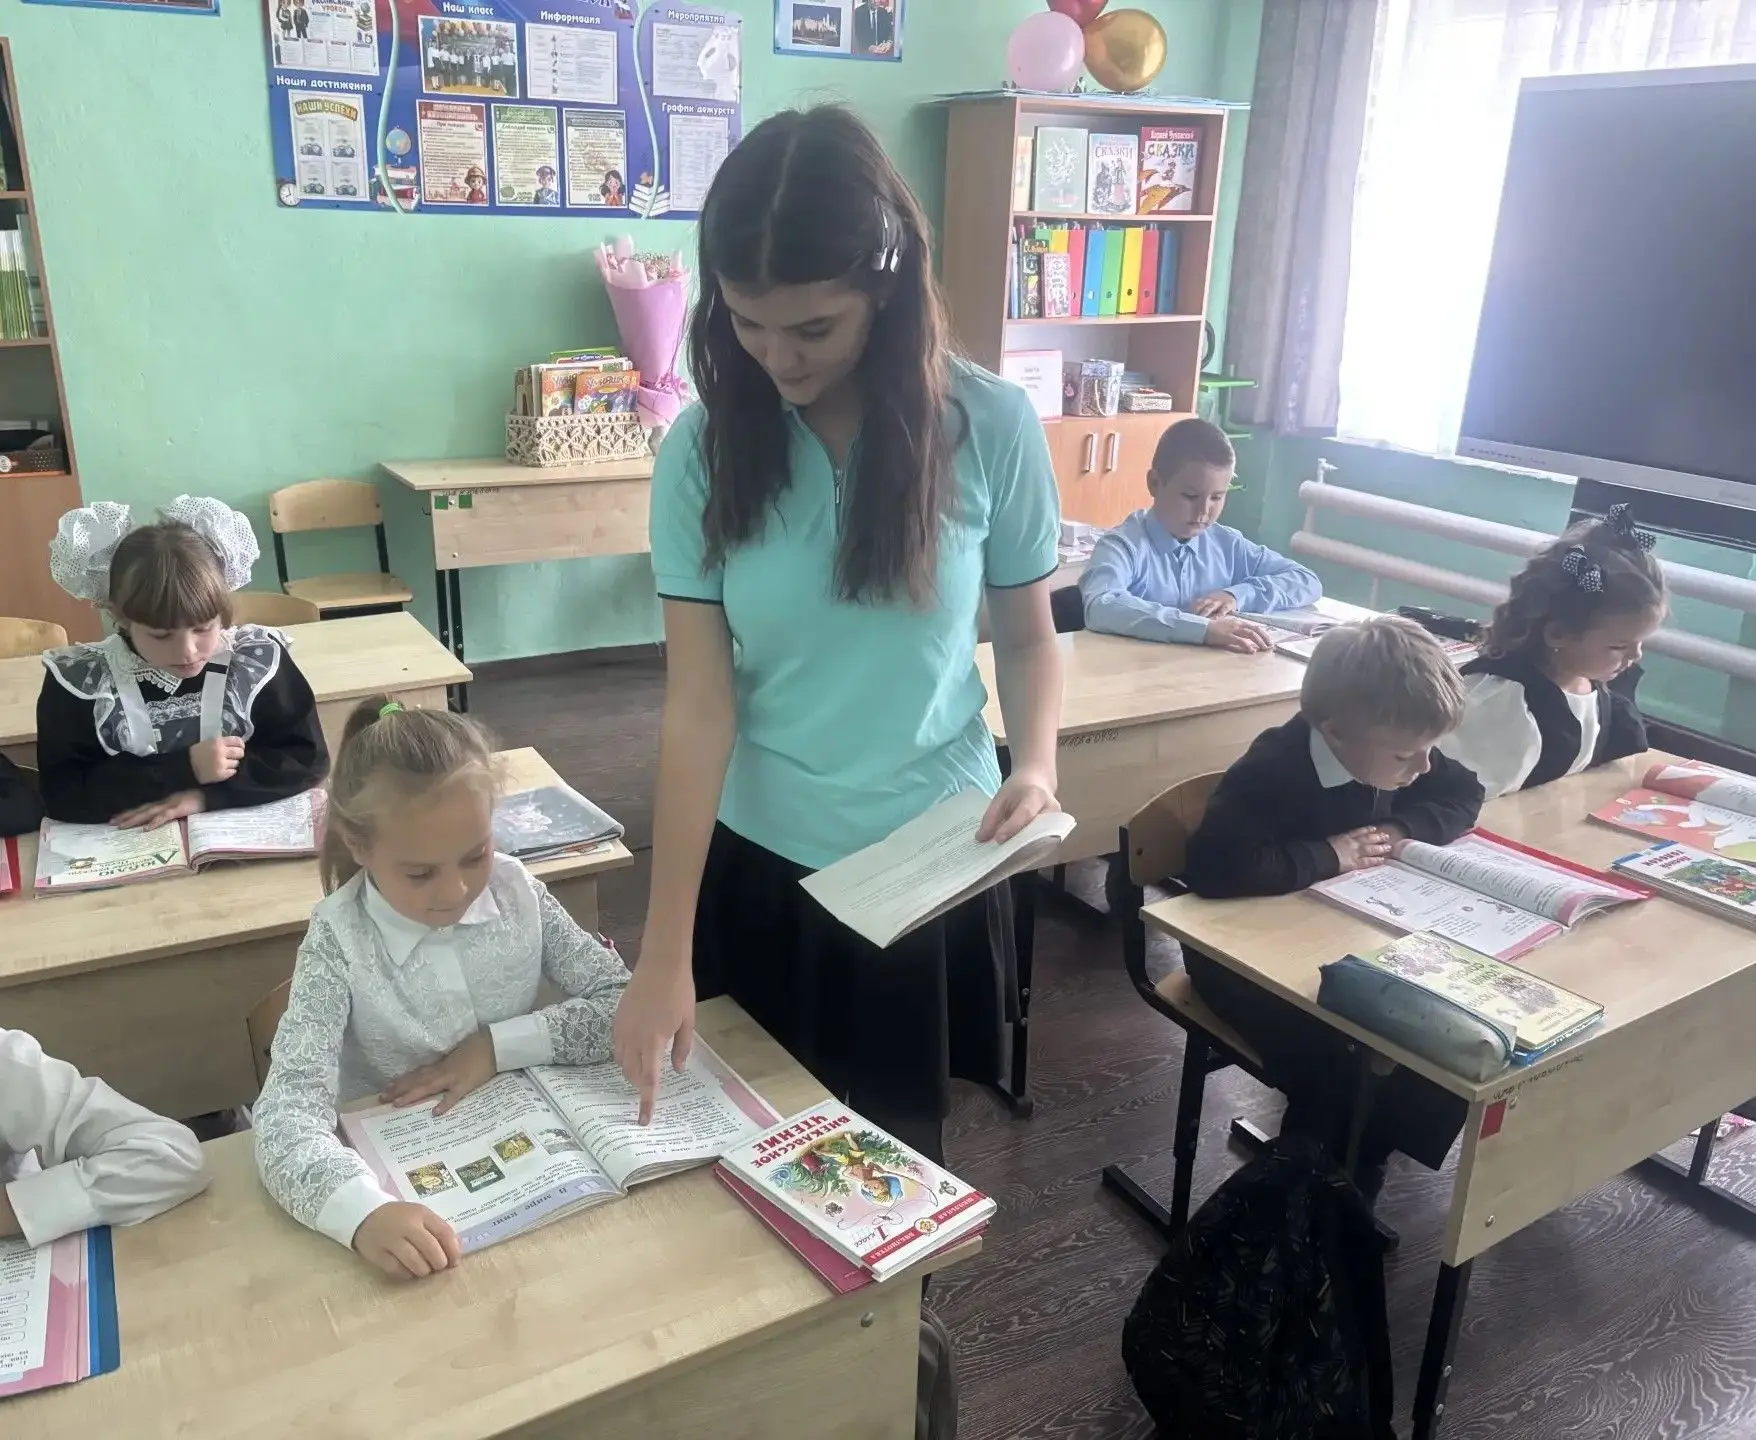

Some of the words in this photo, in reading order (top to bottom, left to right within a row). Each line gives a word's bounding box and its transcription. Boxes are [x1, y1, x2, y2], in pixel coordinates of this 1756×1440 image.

[443, 2, 466, 12] Наш
[469, 4, 494, 15] класс
[667, 9, 725, 24] Мероприятия
[540, 10, 601, 25] Информация
[276, 75, 307, 88] Наши
[310, 80, 373, 92] достижения
[296, 100, 323, 114] НАШИ
[324, 101, 357, 120] УСПЕХИ
[662, 102, 694, 114] График
[696, 106, 736, 116] дежурств
[1095, 145, 1133, 159] СКАЗКИ
[1147, 142, 1195, 158] СКАЗКИ
[752, 1115, 829, 1154] ЧТЕНИЕ
[853, 1230, 877, 1249] класс
[874, 1223, 890, 1242] 1
